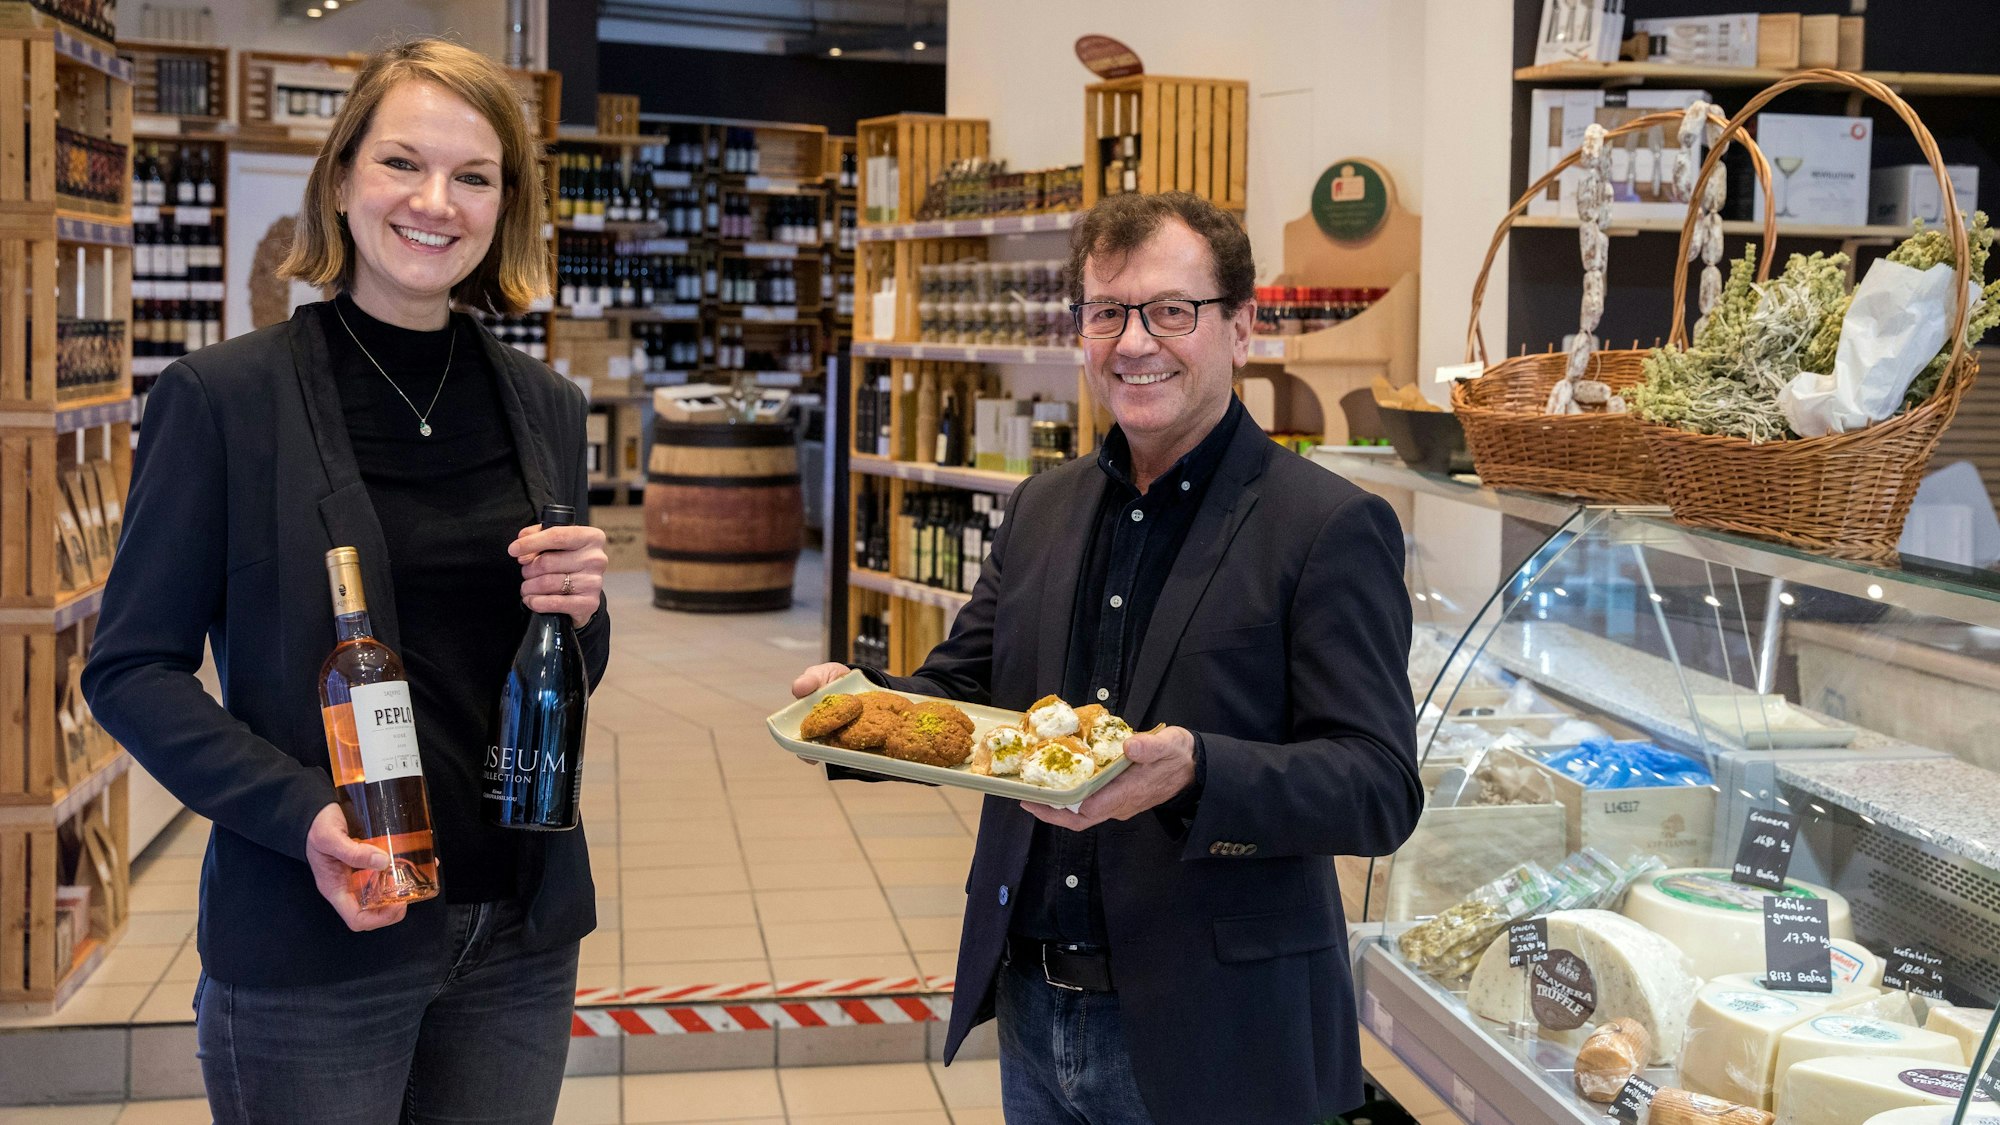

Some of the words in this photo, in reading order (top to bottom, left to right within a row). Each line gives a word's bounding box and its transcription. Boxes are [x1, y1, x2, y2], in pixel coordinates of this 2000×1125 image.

[1783, 932, 1816, 944] 17,90
[1555, 963, 1580, 981] BAFAS
[1769, 970, 1792, 982] 8173
[1797, 969, 1827, 983] Bafas
[1535, 964, 1592, 1002] GRAVIERA
[1536, 983, 1584, 1017] TRUFFLE
